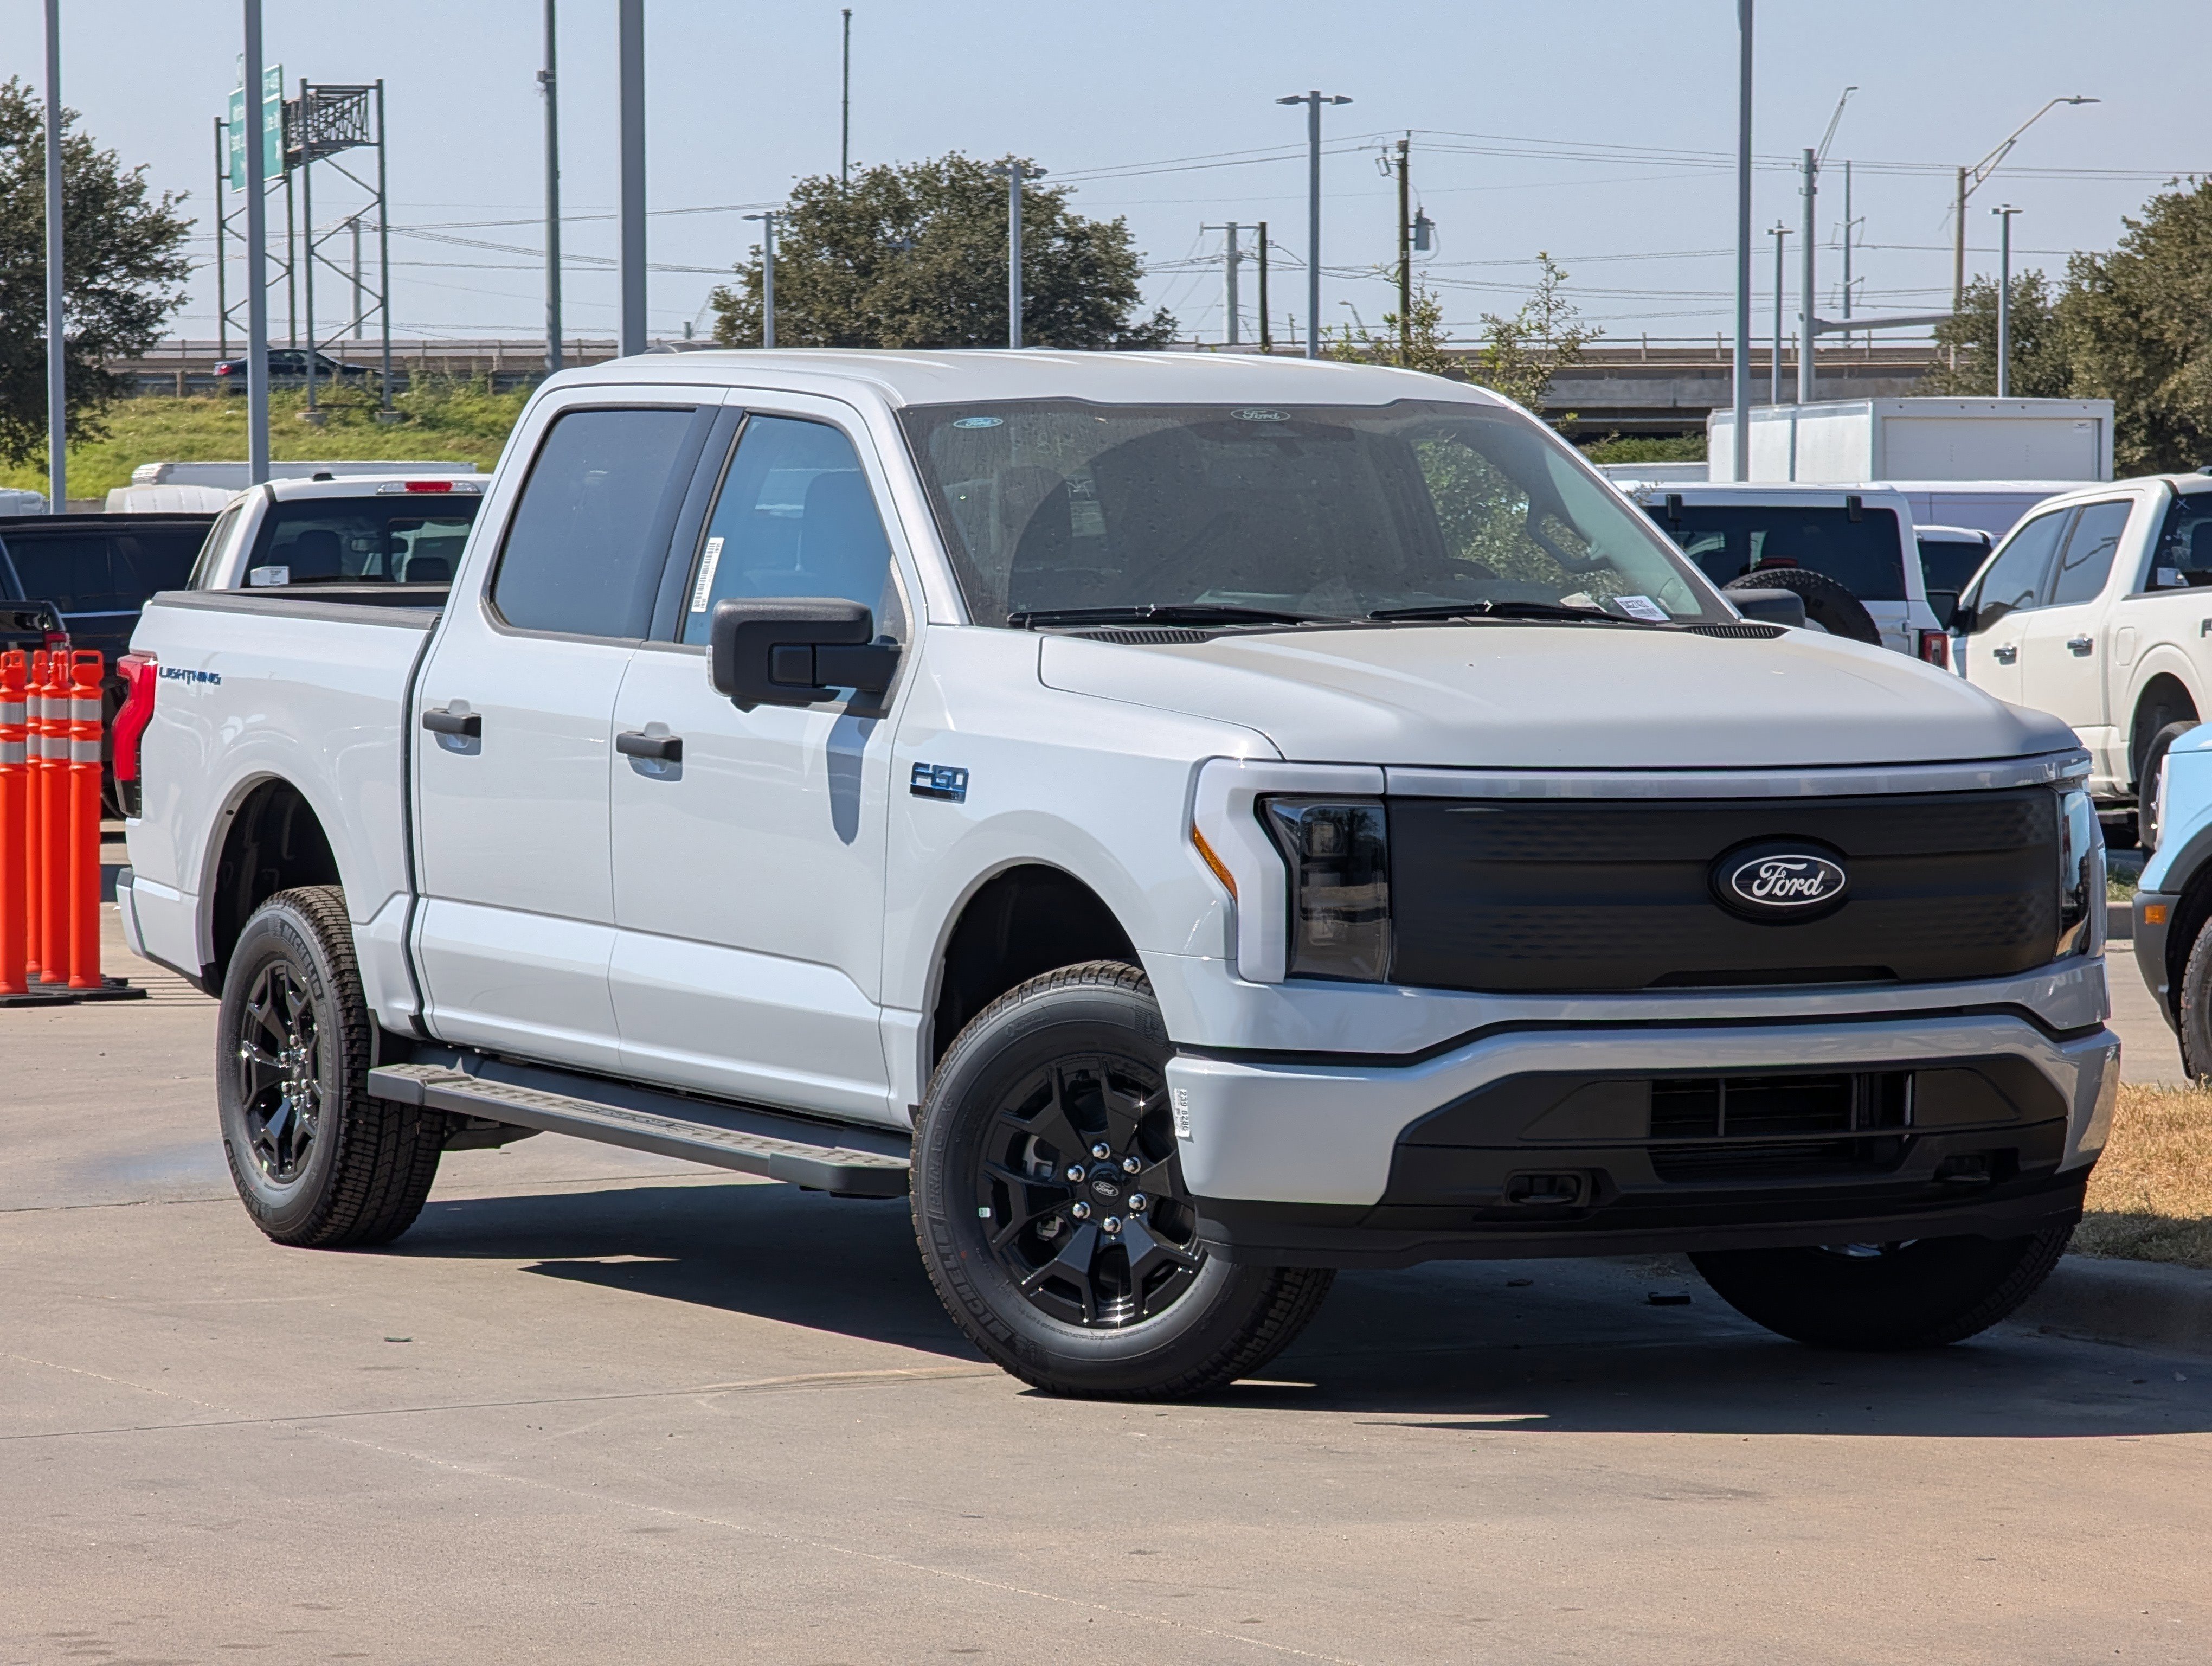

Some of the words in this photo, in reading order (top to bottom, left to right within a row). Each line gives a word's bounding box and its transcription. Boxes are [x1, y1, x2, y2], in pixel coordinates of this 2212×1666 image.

[1243, 410, 1280, 419] Ford
[159, 666, 221, 686] LIGHTNING
[1752, 861, 1825, 896] Ford
[282, 924, 322, 997] MICHELIN
[225, 1143, 260, 1216] MICHELIN
[931, 1222, 1012, 1343] MICHELIN
